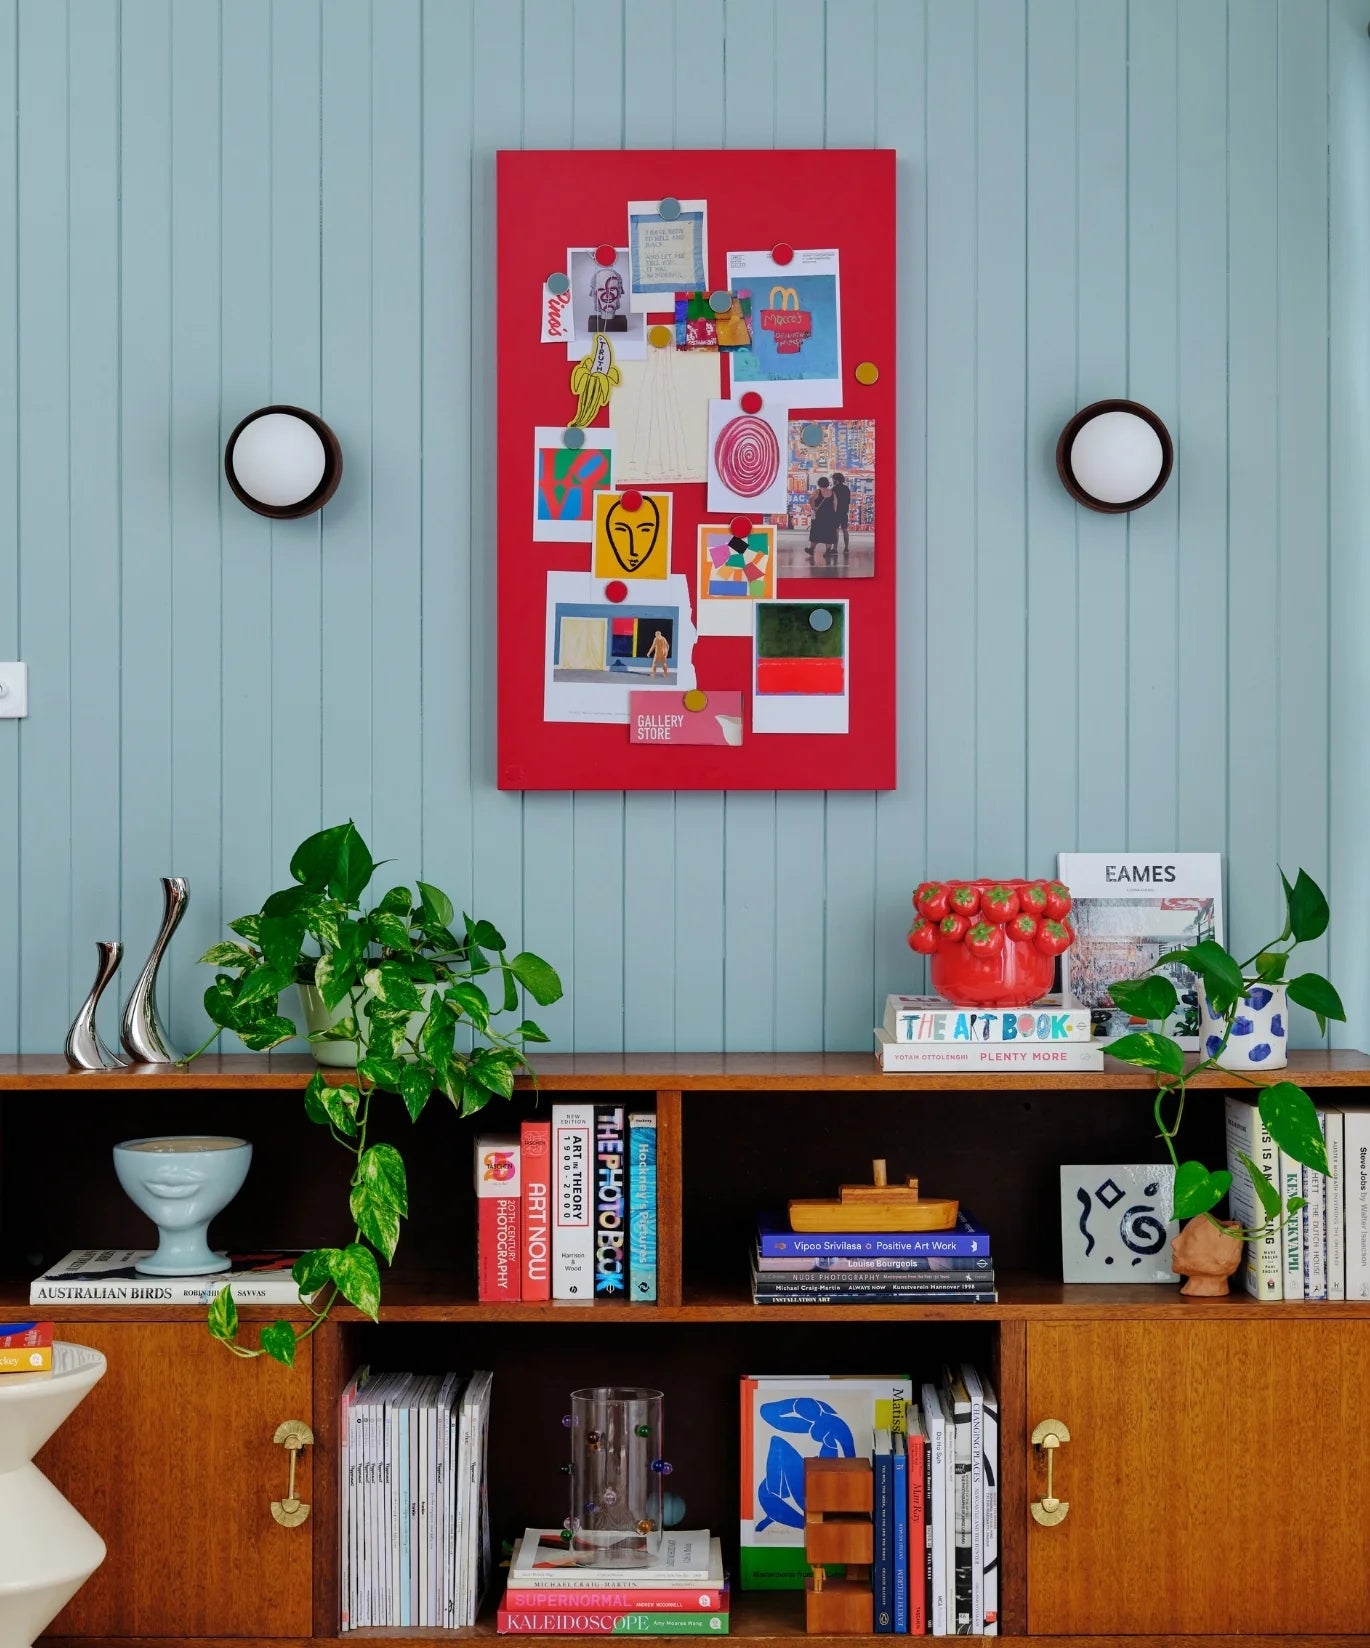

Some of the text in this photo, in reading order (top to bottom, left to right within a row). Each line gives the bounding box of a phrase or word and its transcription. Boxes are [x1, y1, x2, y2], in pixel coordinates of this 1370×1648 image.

[596, 341, 606, 371] TRUTH
[637, 715, 684, 727] GALLERY
[637, 728, 671, 740] STORE
[1106, 866, 1176, 882] EAMES
[899, 1013, 947, 1041] THE
[953, 1013, 998, 1041] ART
[980, 1052, 1027, 1061] PLENTY
[1032, 1052, 1067, 1061] MORE
[597, 1108, 623, 1153] THE
[573, 1136, 582, 1160] ART
[1263, 1148, 1272, 1160] IS
[573, 1172, 582, 1220] THEORY
[597, 1153, 624, 1229] PHOTO
[1360, 1192, 1367, 1201] by
[638, 1143, 648, 1263] Hockney's Pictures
[528, 1183, 546, 1280] ART NOW
[497, 1199, 507, 1288] PHOTOGRAPHY
[794, 1242, 957, 1252] Vipoo Srivilasa Positive Art Work
[876, 1260, 917, 1269] Bourgeois
[38, 1287, 127, 1299] AUSTRALIAN
[131, 1287, 172, 1299] BIRDS
[892, 1388, 904, 1434] Matiss
[936, 1432, 942, 1440] Do
[936, 1442, 942, 1451] Ho
[913, 1483, 921, 1505] Man
[912, 1505, 921, 1523] Ray
[515, 1594, 632, 1607] SUPERNORMAL
[507, 1615, 649, 1630] KALEIDOSCOPE
